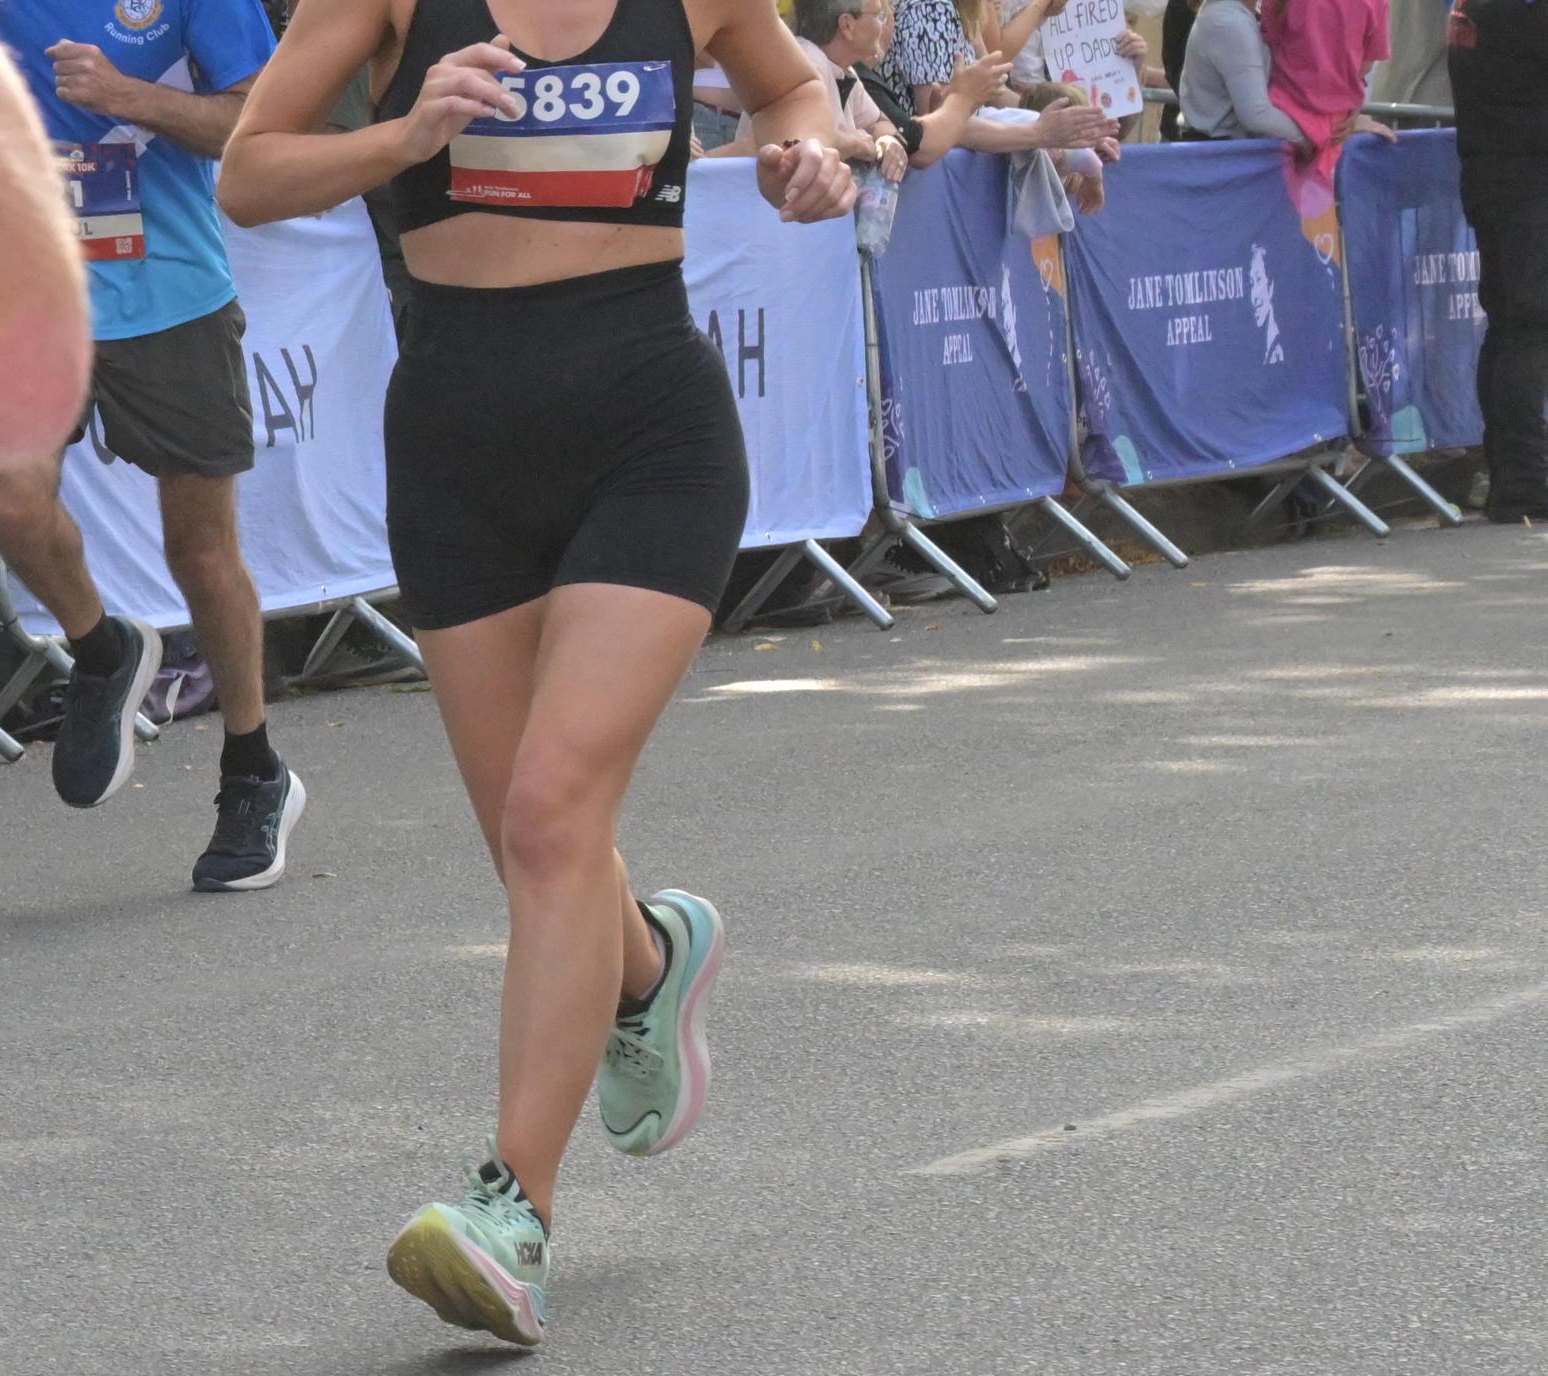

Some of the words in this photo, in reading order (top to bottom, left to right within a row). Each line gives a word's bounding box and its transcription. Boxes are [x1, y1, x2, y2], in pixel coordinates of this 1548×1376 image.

[104, 22, 144, 45] Running
[146, 23, 170, 41] Club
[1050, 8, 1073, 37] ALL
[1053, 43, 1074, 70] UP
[1081, 37, 1120, 64] DADD
[495, 71, 640, 122] 5839
[1414, 254, 1446, 285] JANE
[1128, 275, 1163, 310] JANE
[1165, 267, 1244, 307] TOMLINSON
[913, 288, 939, 325] JANE
[1167, 315, 1212, 346] APPEAL
[943, 333, 973, 365] APPEAL
